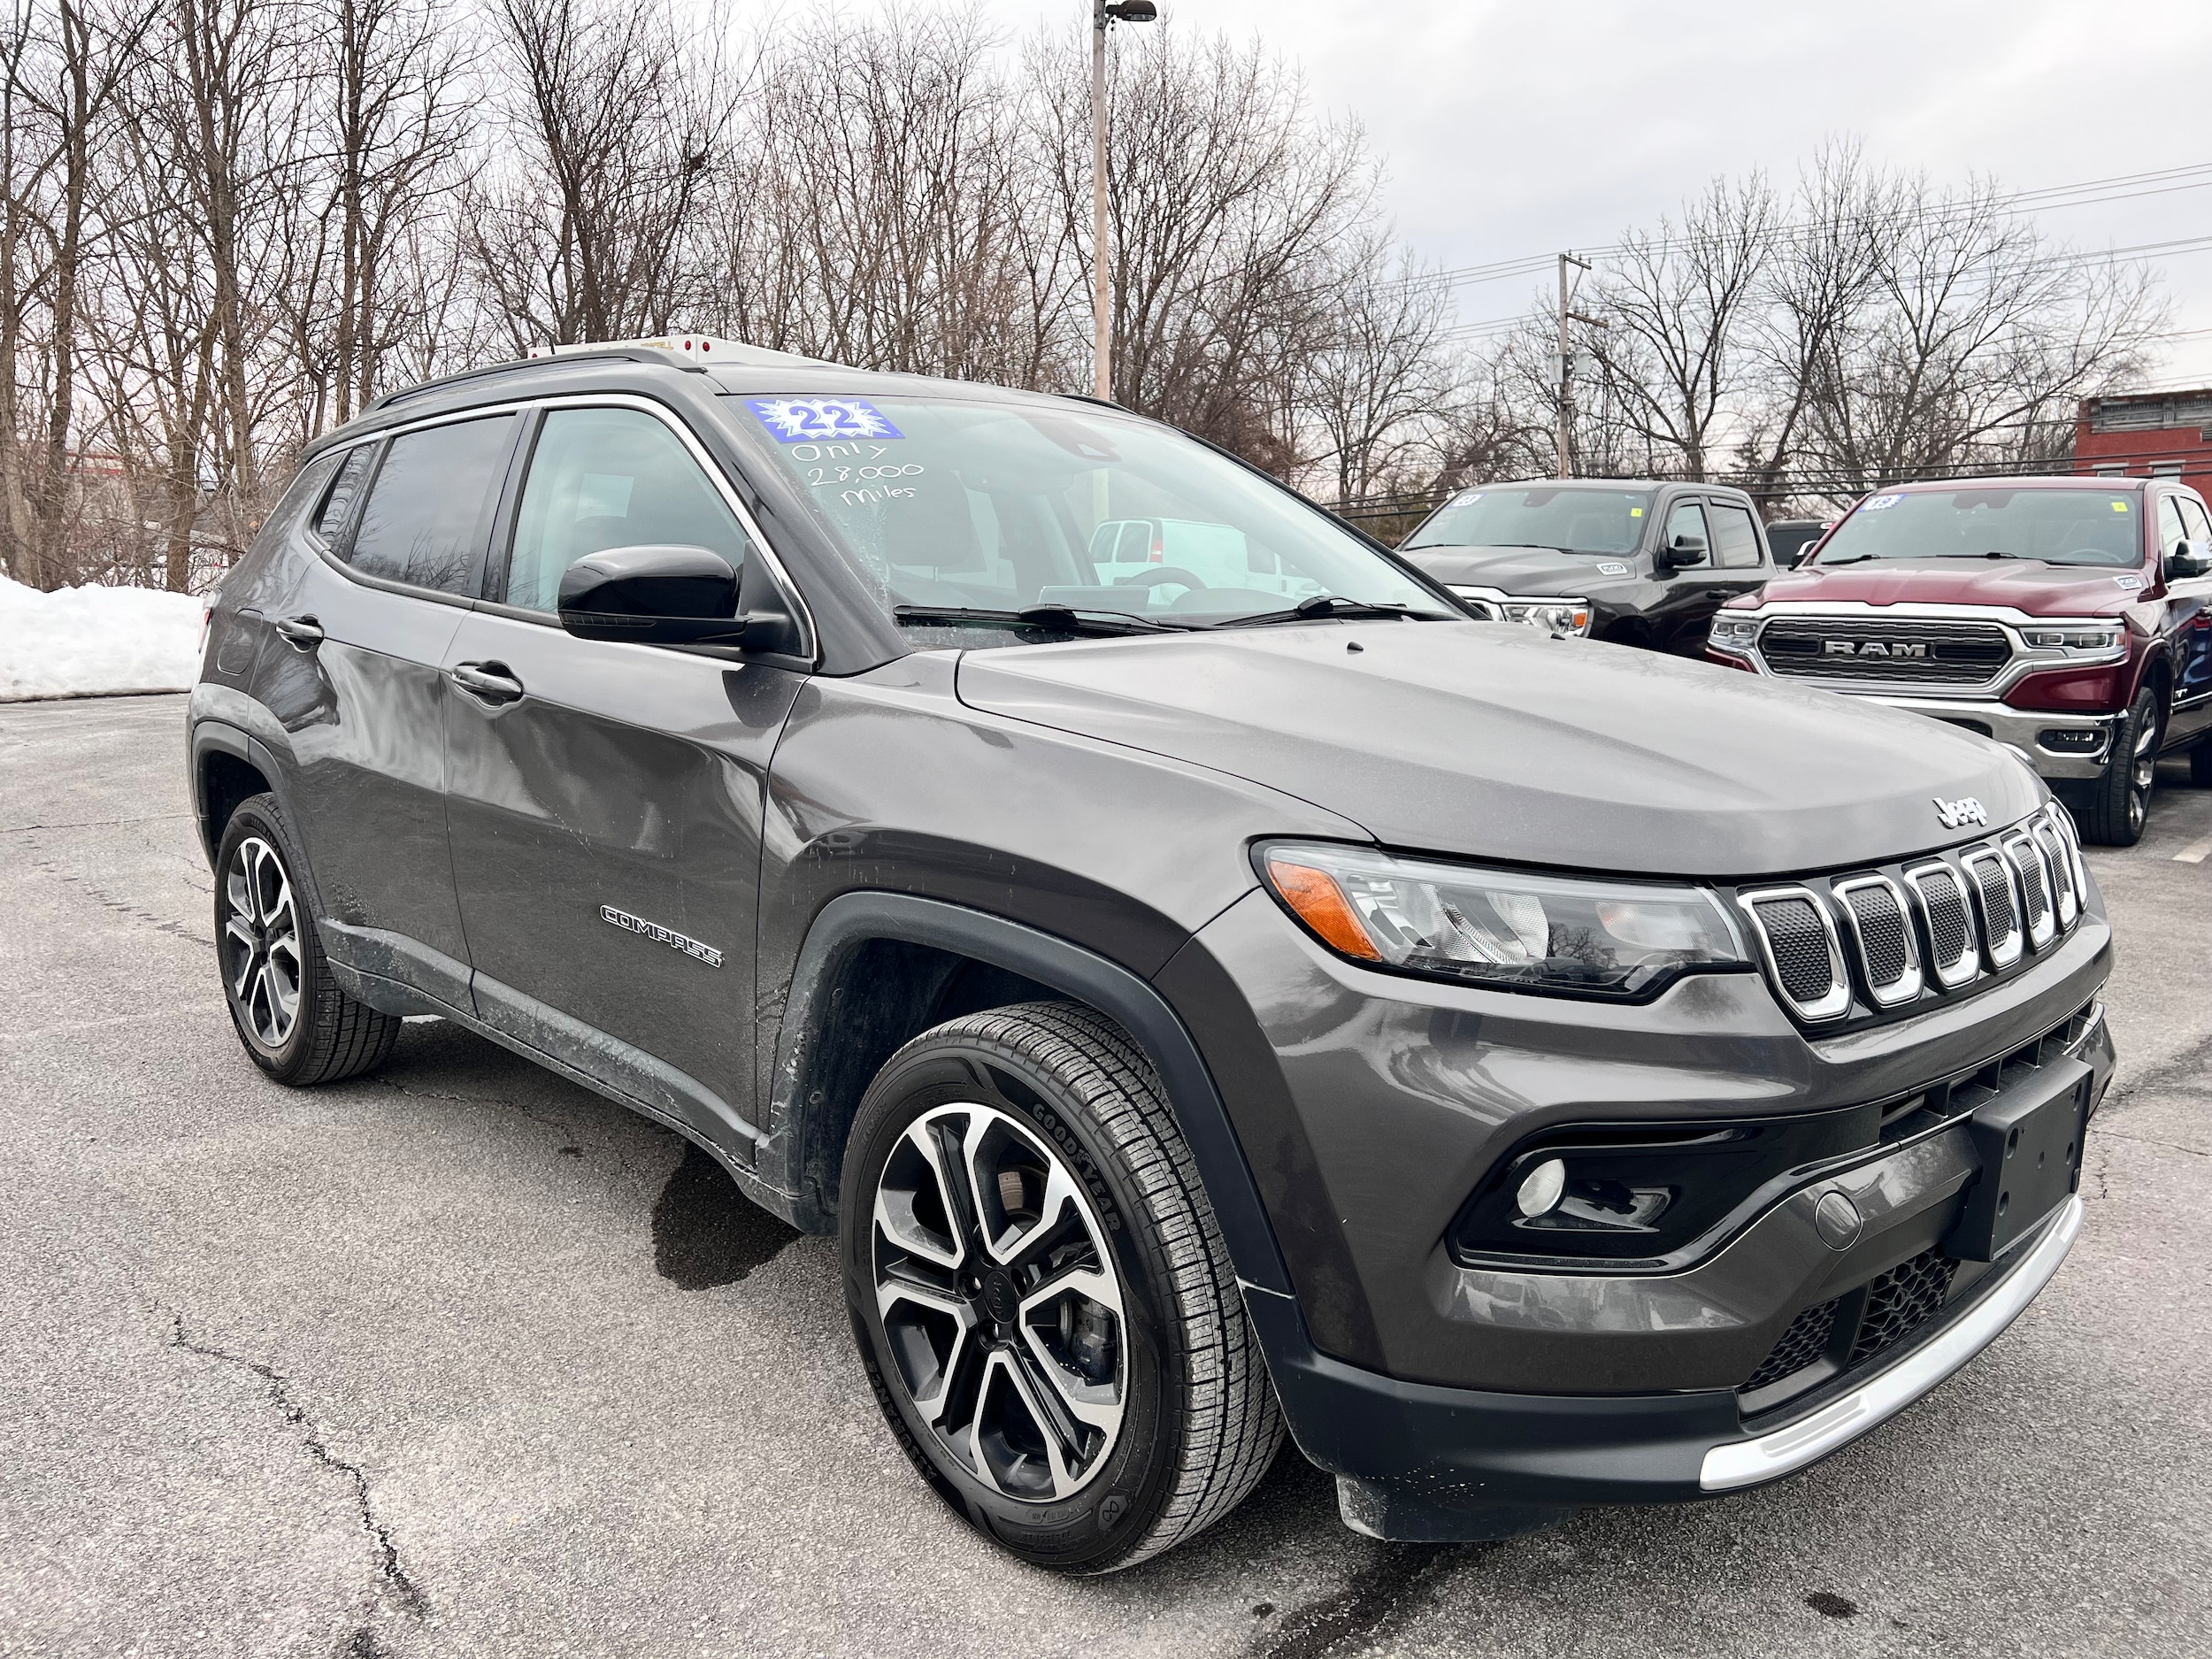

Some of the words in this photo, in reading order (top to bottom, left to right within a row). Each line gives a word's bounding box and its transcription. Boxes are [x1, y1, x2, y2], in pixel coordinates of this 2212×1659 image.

[788, 404, 862, 430] 22
[791, 442, 887, 462] Only
[807, 459, 925, 487] 28,000
[1824, 640, 1927, 657] RAM
[1932, 796, 1987, 829] Jeep
[599, 904, 725, 969] COMPASS
[1032, 1102, 1121, 1231] GOODYEAR
